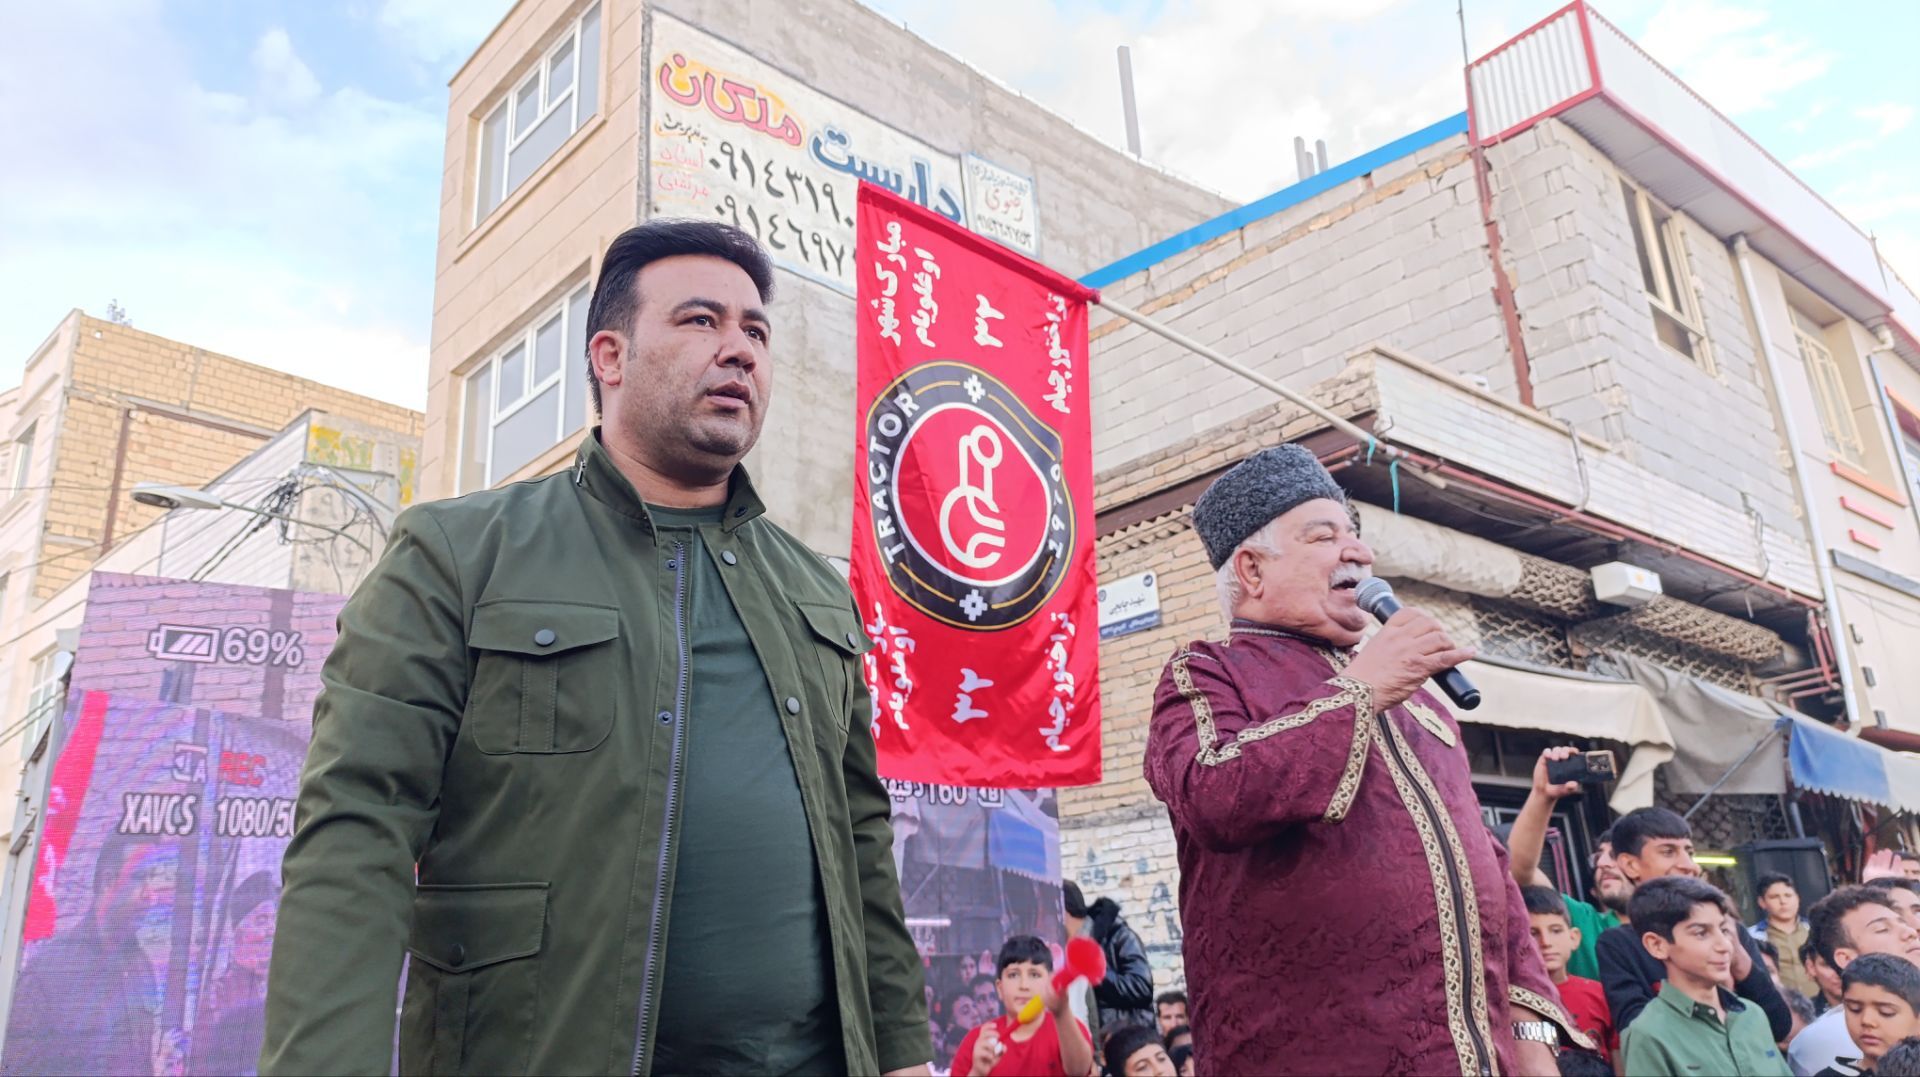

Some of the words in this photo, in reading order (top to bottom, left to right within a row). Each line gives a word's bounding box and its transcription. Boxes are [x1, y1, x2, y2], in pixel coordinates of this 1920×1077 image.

[659, 53, 802, 146] ملکان
[875, 221, 907, 297] مبارک
[869, 392, 920, 564] TRACTOR
[1048, 463, 1065, 560] 1970
[222, 627, 303, 667] 69%
[221, 751, 266, 787] REC
[120, 793, 197, 835] XAVCS
